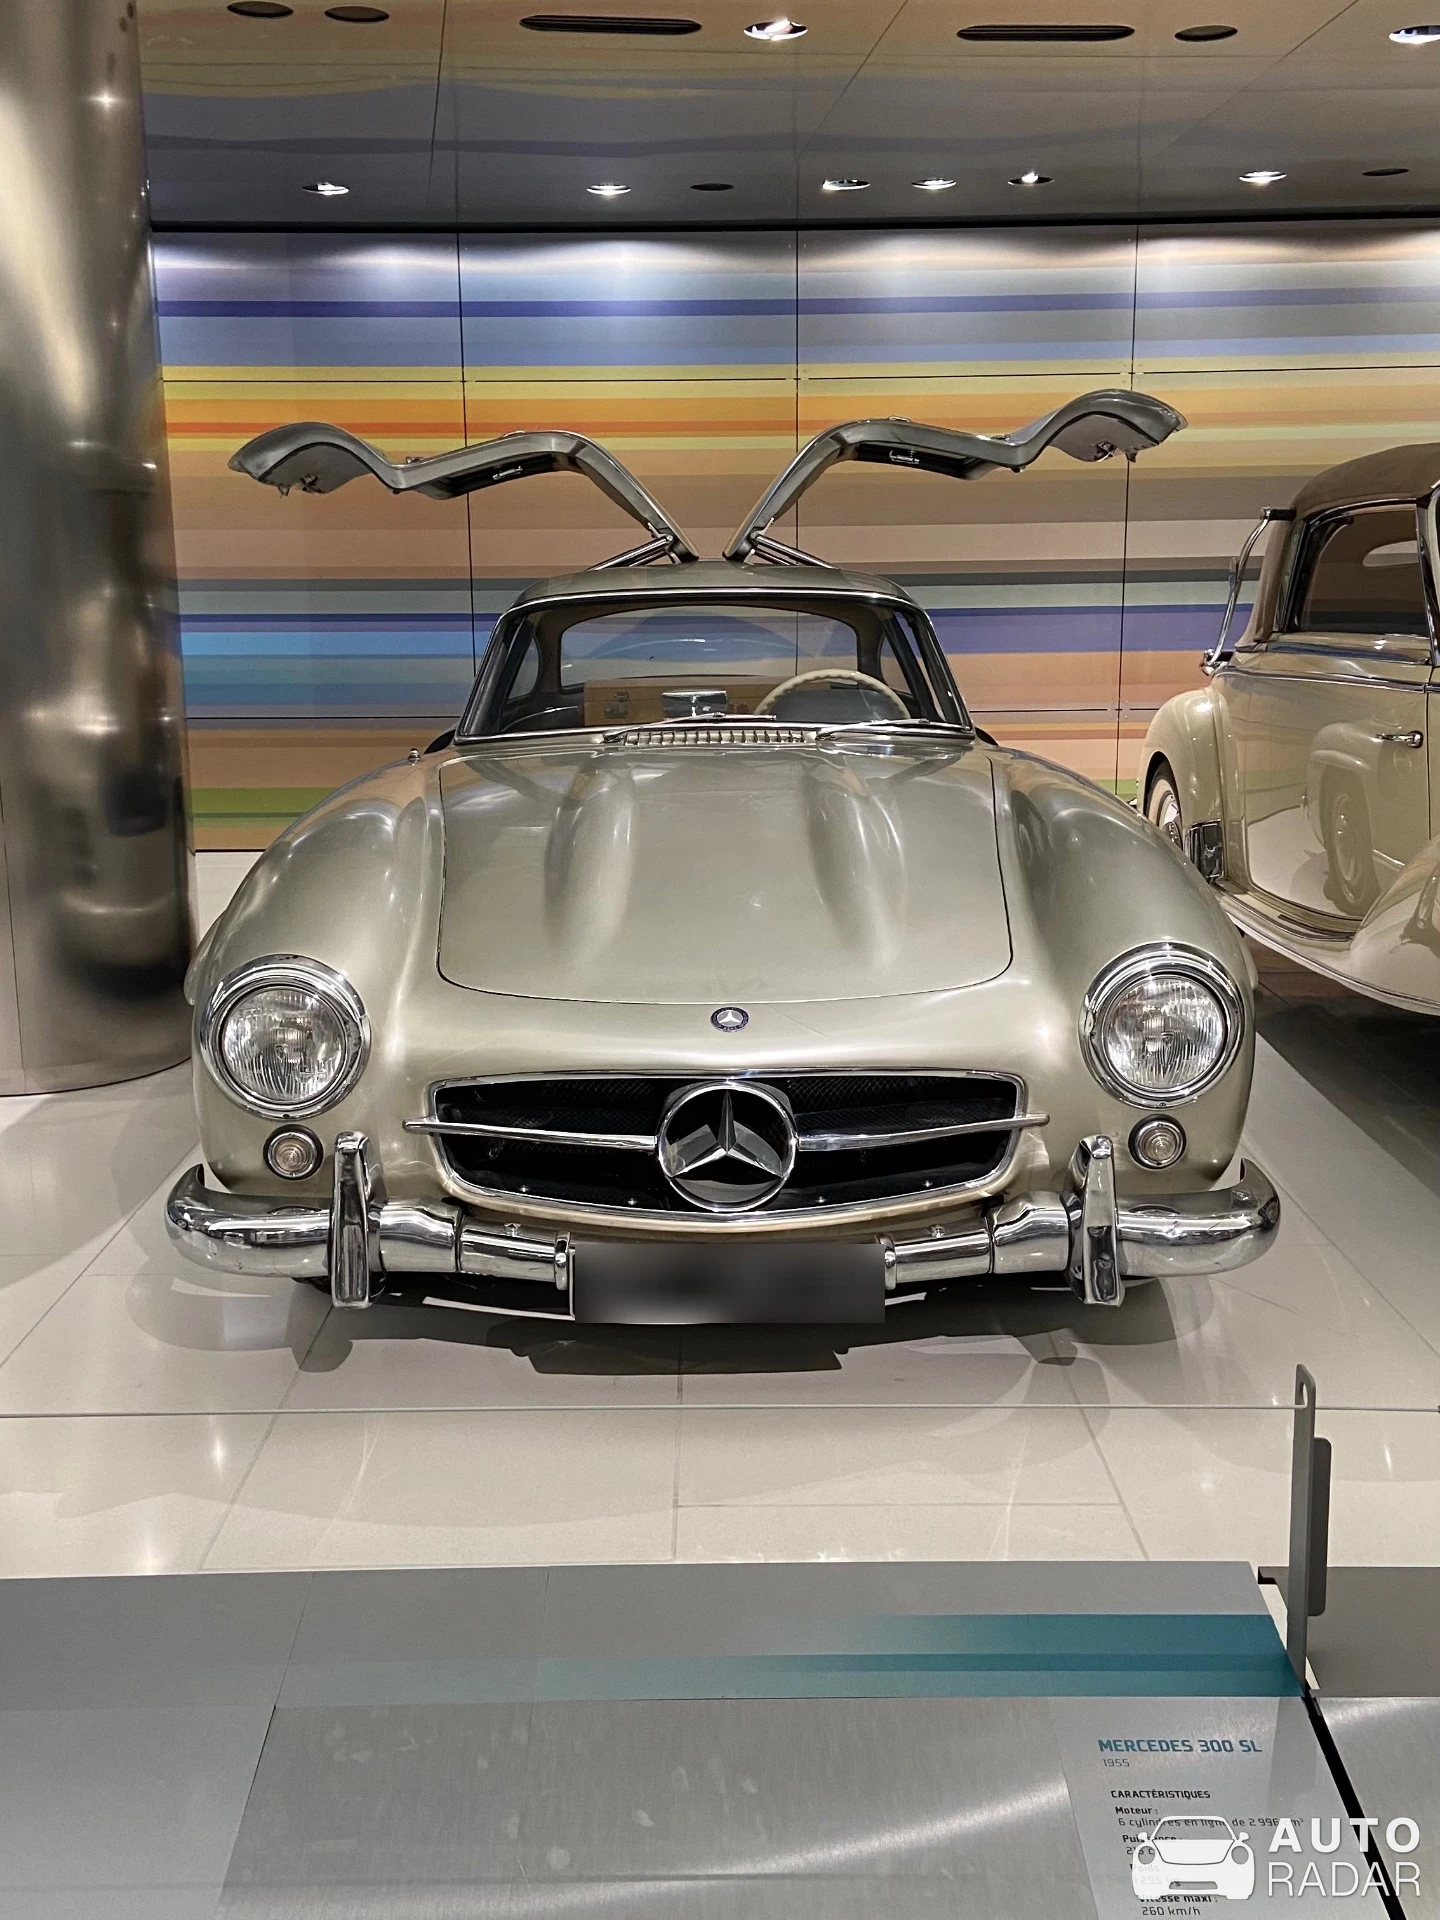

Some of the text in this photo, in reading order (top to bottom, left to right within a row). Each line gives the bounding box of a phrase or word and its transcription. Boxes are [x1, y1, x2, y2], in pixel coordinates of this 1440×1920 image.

[1098, 1739, 1263, 1752] MERCEDES 300 SL
[1103, 1758, 1130, 1767] 1955
[1110, 1789, 1211, 1800] CARACTÉRISTIQUES
[1115, 1806, 1153, 1815] Moteur
[1118, 1817, 1126, 1827] 6
[1231, 1817, 1245, 1827] de
[1183, 1893, 1212, 1903] maxi
[1142, 1906, 1201, 1916] 260 km/h
